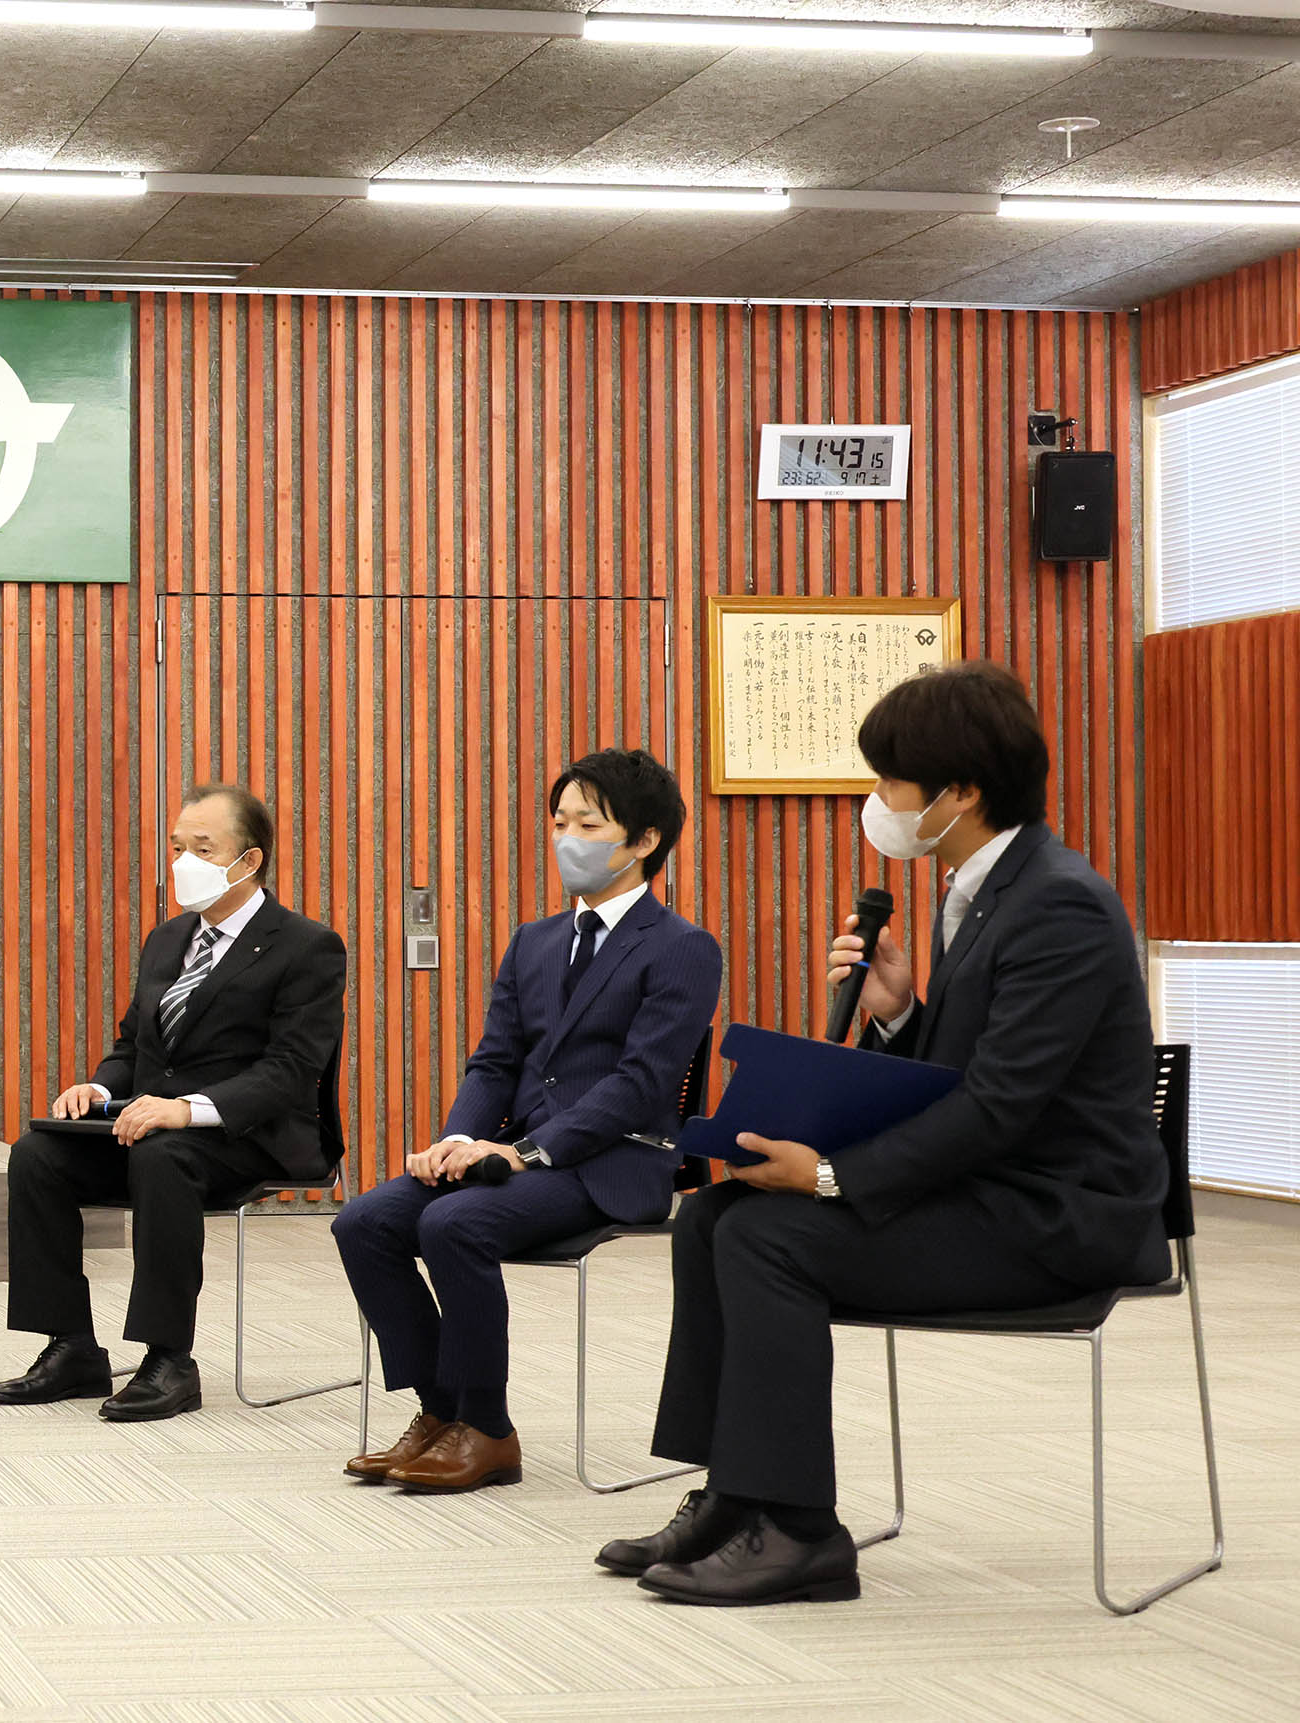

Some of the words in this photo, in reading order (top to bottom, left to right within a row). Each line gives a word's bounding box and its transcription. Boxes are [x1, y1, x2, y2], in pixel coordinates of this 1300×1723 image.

[796, 438, 865, 469] 11:43
[870, 452, 884, 469] 15
[840, 471, 849, 485] 9
